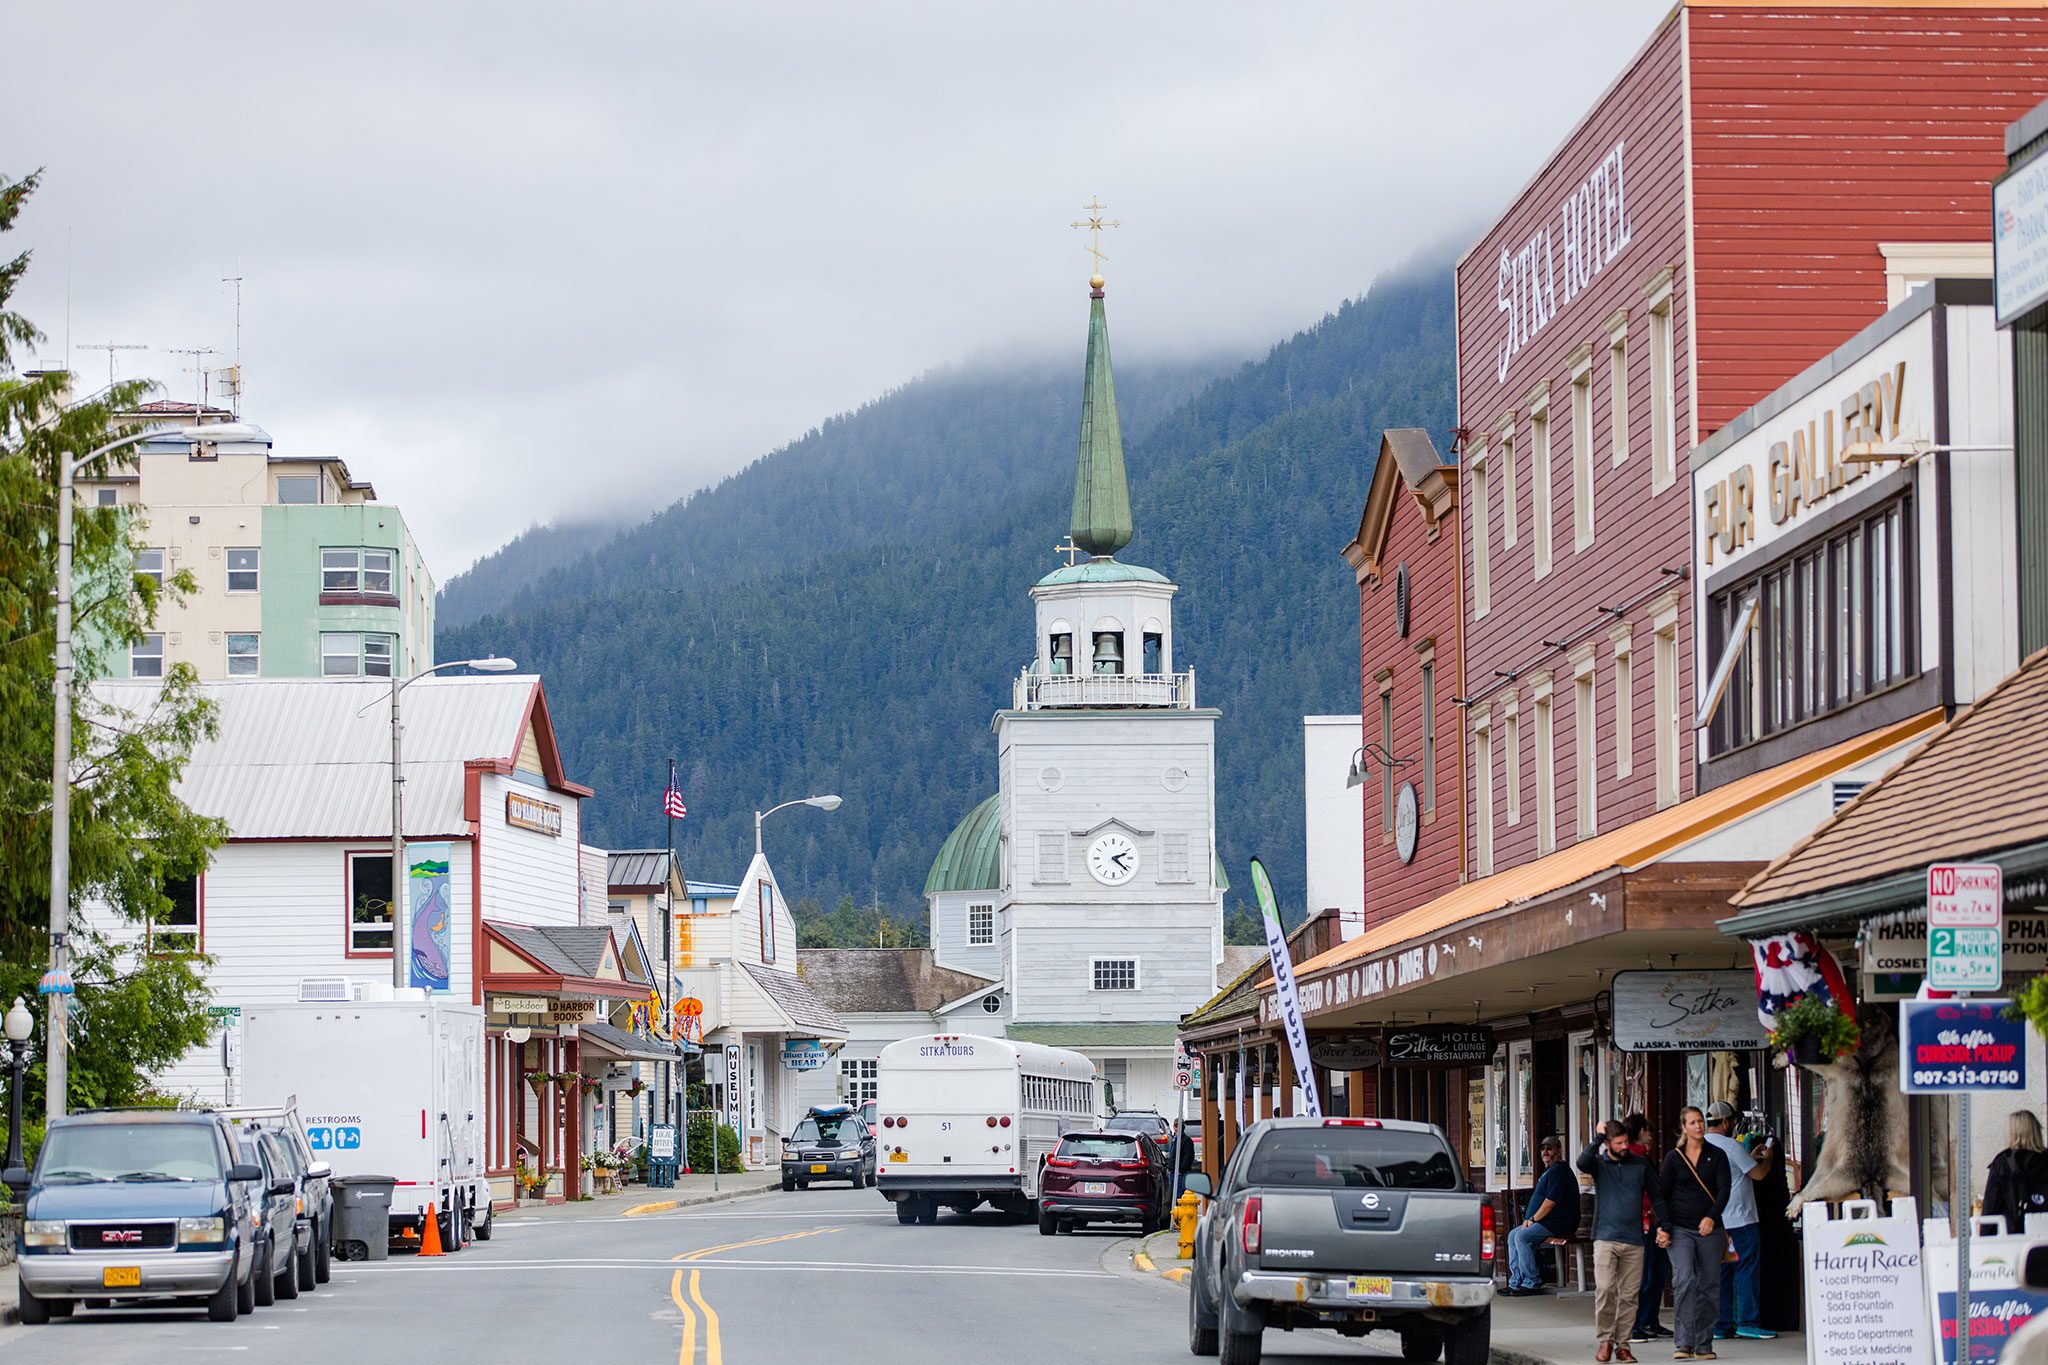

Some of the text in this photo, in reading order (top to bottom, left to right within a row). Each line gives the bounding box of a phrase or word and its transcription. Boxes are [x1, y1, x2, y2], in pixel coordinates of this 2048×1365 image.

[1498, 141, 1632, 384] SITKA HOTEL
[1704, 361, 1906, 565] FUR GALLERY
[1932, 869, 1997, 895] NO PARKING
[1879, 919, 2048, 940] HARR PHA
[1935, 930, 1951, 955] 2
[1961, 932, 1990, 941] HOUR
[1956, 943, 1997, 958] PARKING
[1877, 958, 1927, 969] COSMET
[1336, 973, 1349, 1005] BAR
[1362, 960, 1383, 997] LUNCH
[1398, 947, 1424, 987] DINNER
[560, 1002, 595, 1012] HARBOR
[1650, 987, 1740, 1029] Sitka
[554, 1012, 584, 1022] BOOKS
[1442, 1033, 1486, 1042] HOTEL
[1937, 1029, 1995, 1049] We offer
[920, 1046, 974, 1056] SITKA TOURS
[1389, 1034, 1448, 1057] Sitka
[1453, 1043, 1487, 1051] LOUNGE
[1633, 1041, 1671, 1050] ALASKA
[1678, 1040, 1725, 1049] WYOMING
[1732, 1040, 1758, 1048] UTAH
[1313, 1046, 1347, 1060] Silver
[1434, 1052, 1487, 1060] RESTAURANT
[1917, 1044, 2016, 1064] CURBSIDE PICKUP
[729, 1050, 739, 1112] MUSEUM
[306, 1116, 361, 1124] RESTROOMS
[941, 1122, 951, 1131] 51
[102, 1231, 142, 1242] GMC
[1265, 1249, 1315, 1258] FRONTIER
[1814, 1250, 1918, 1273] Harry Race
[1825, 1274, 1899, 1285] Local Pharmacy
[1826, 1290, 1880, 1300] Old Fashion
[1827, 1300, 1894, 1311] Soda Fountain
[1969, 1300, 2032, 1321] We offer
[1828, 1313, 1883, 1325] Local Artists
[1941, 1317, 2007, 1339] CUBSIDE
[1829, 1329, 1913, 1341] Photo Department
[1829, 1344, 1912, 1356] Sea Sick Medicine
